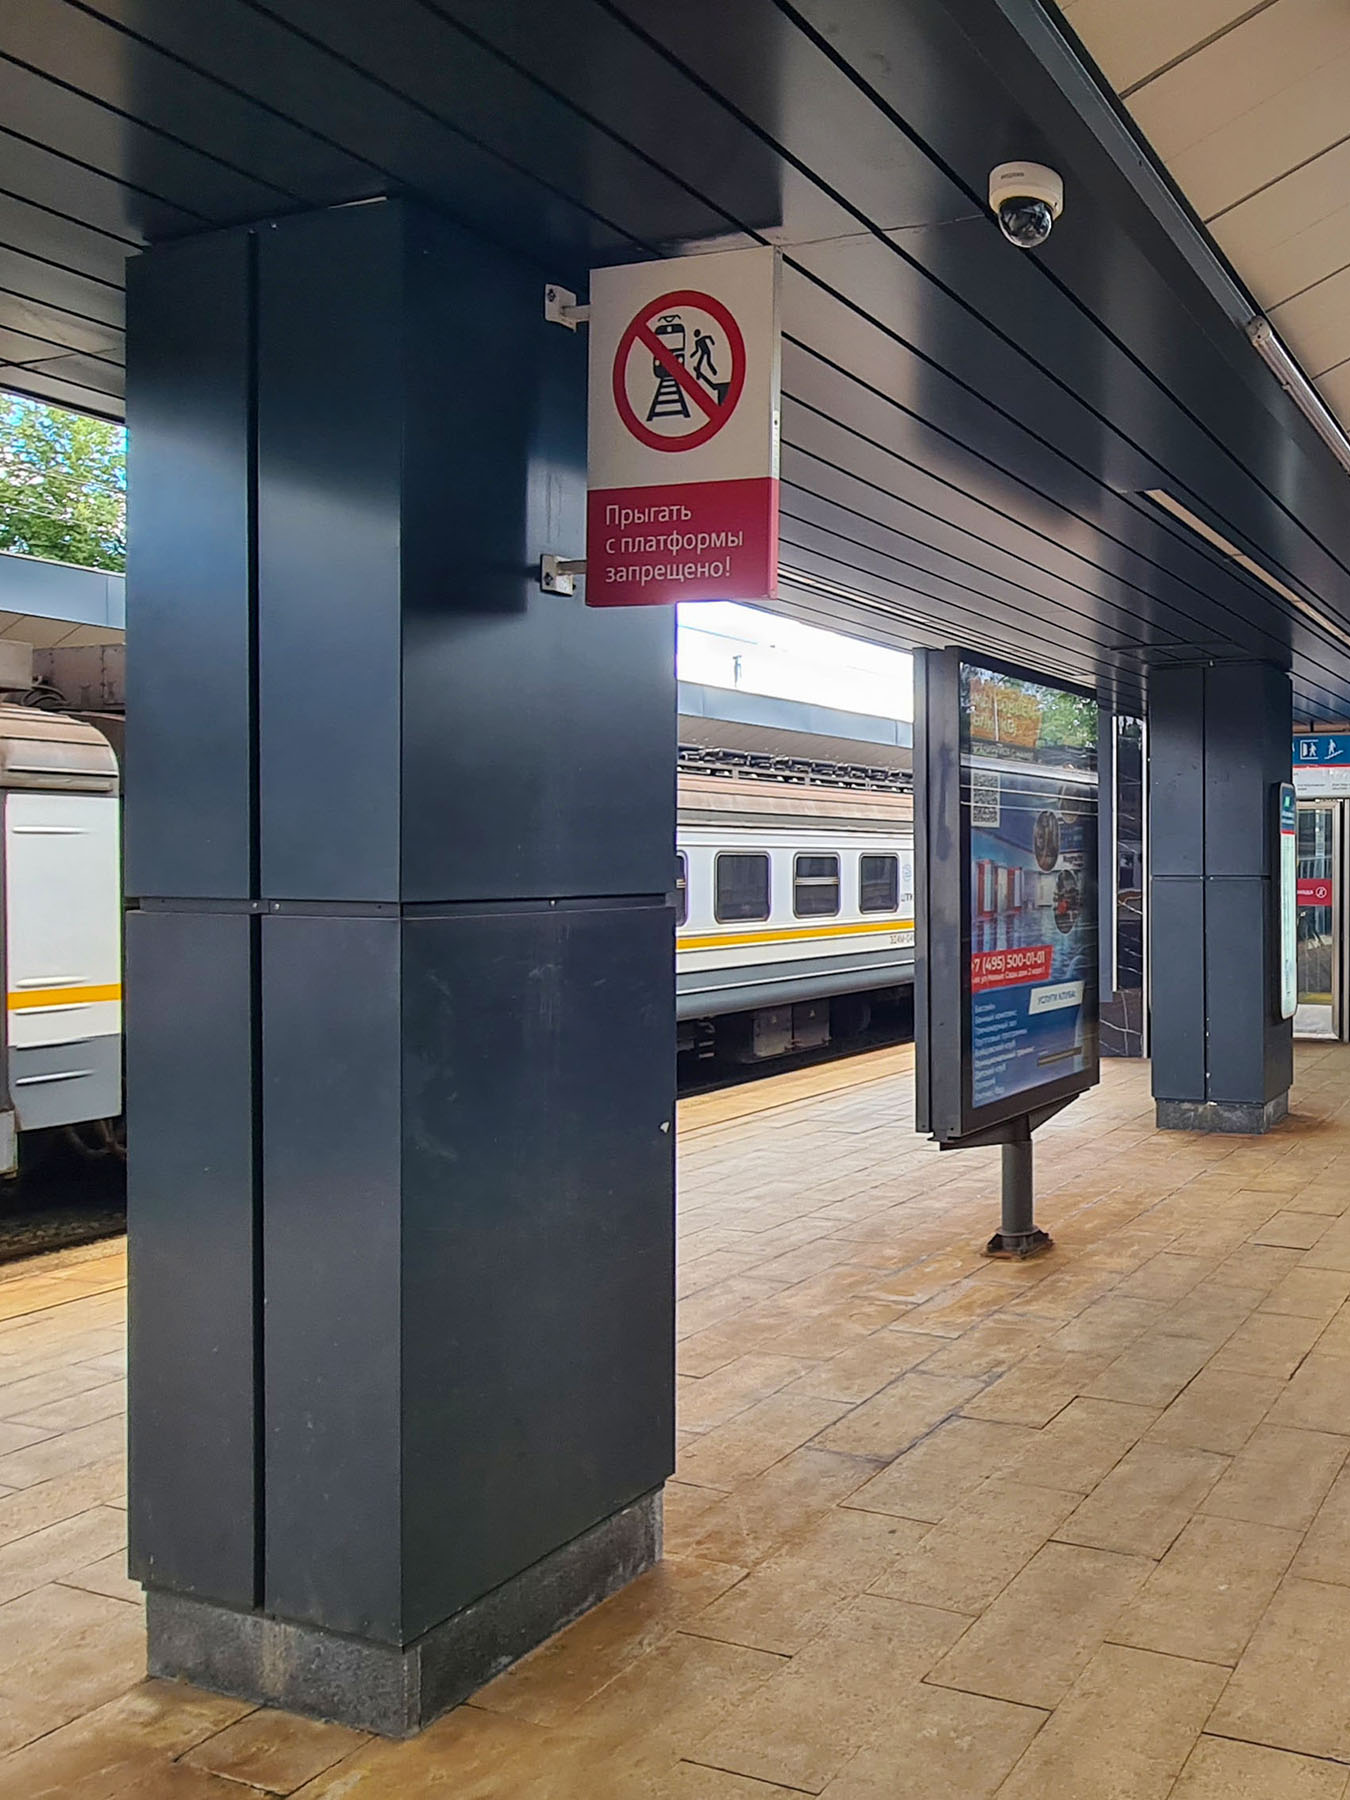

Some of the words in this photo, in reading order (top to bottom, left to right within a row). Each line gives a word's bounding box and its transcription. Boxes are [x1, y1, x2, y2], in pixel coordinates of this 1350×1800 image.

[605, 504, 692, 530] Прыгать
[605, 538, 616, 554] с
[621, 530, 744, 556] платформы
[605, 555, 731, 587] запрещено!
[1006, 950, 1046, 969] 500-01-01
